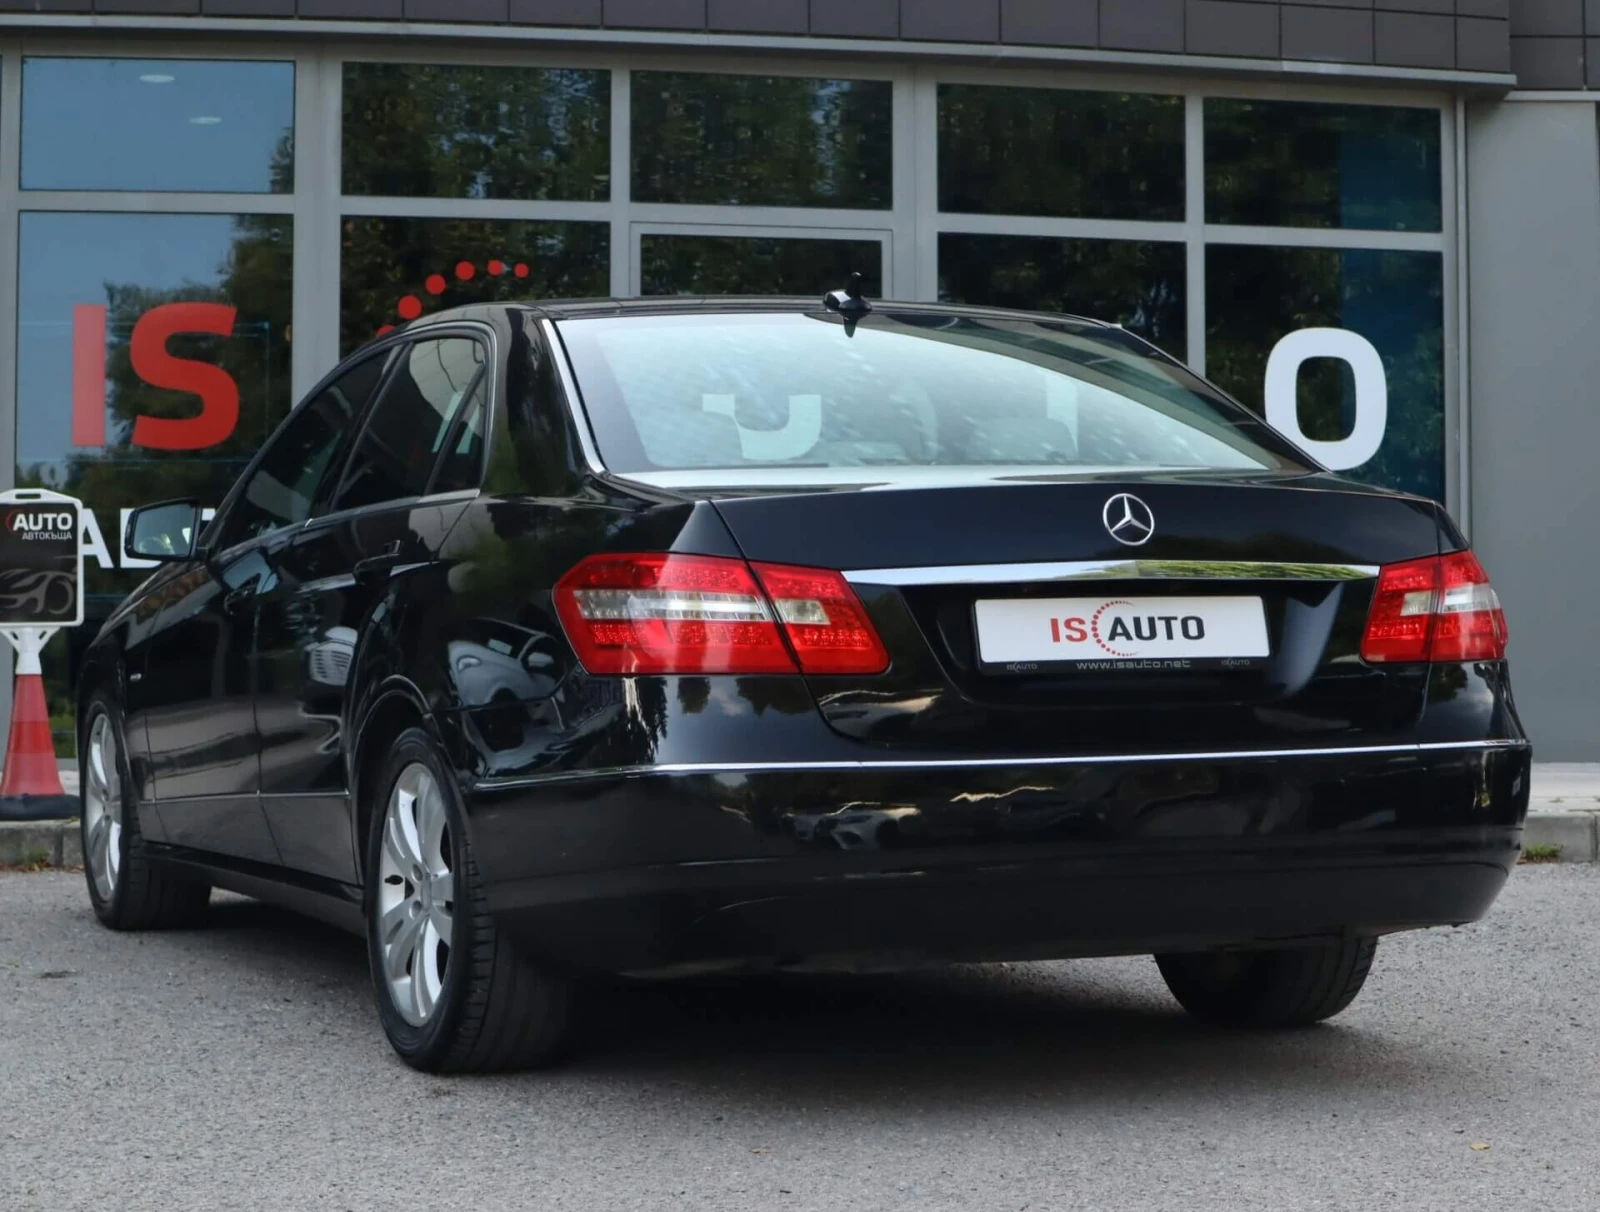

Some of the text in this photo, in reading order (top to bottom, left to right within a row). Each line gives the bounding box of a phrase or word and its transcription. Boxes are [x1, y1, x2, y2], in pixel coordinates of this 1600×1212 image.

[72, 302, 240, 449] IS
[13, 512, 73, 532] AUTO
[22, 532, 73, 541] АВТОКЪЩА
[1050, 616, 1205, 643] IS AUTO
[1076, 659, 1191, 670] www.isauto.net
